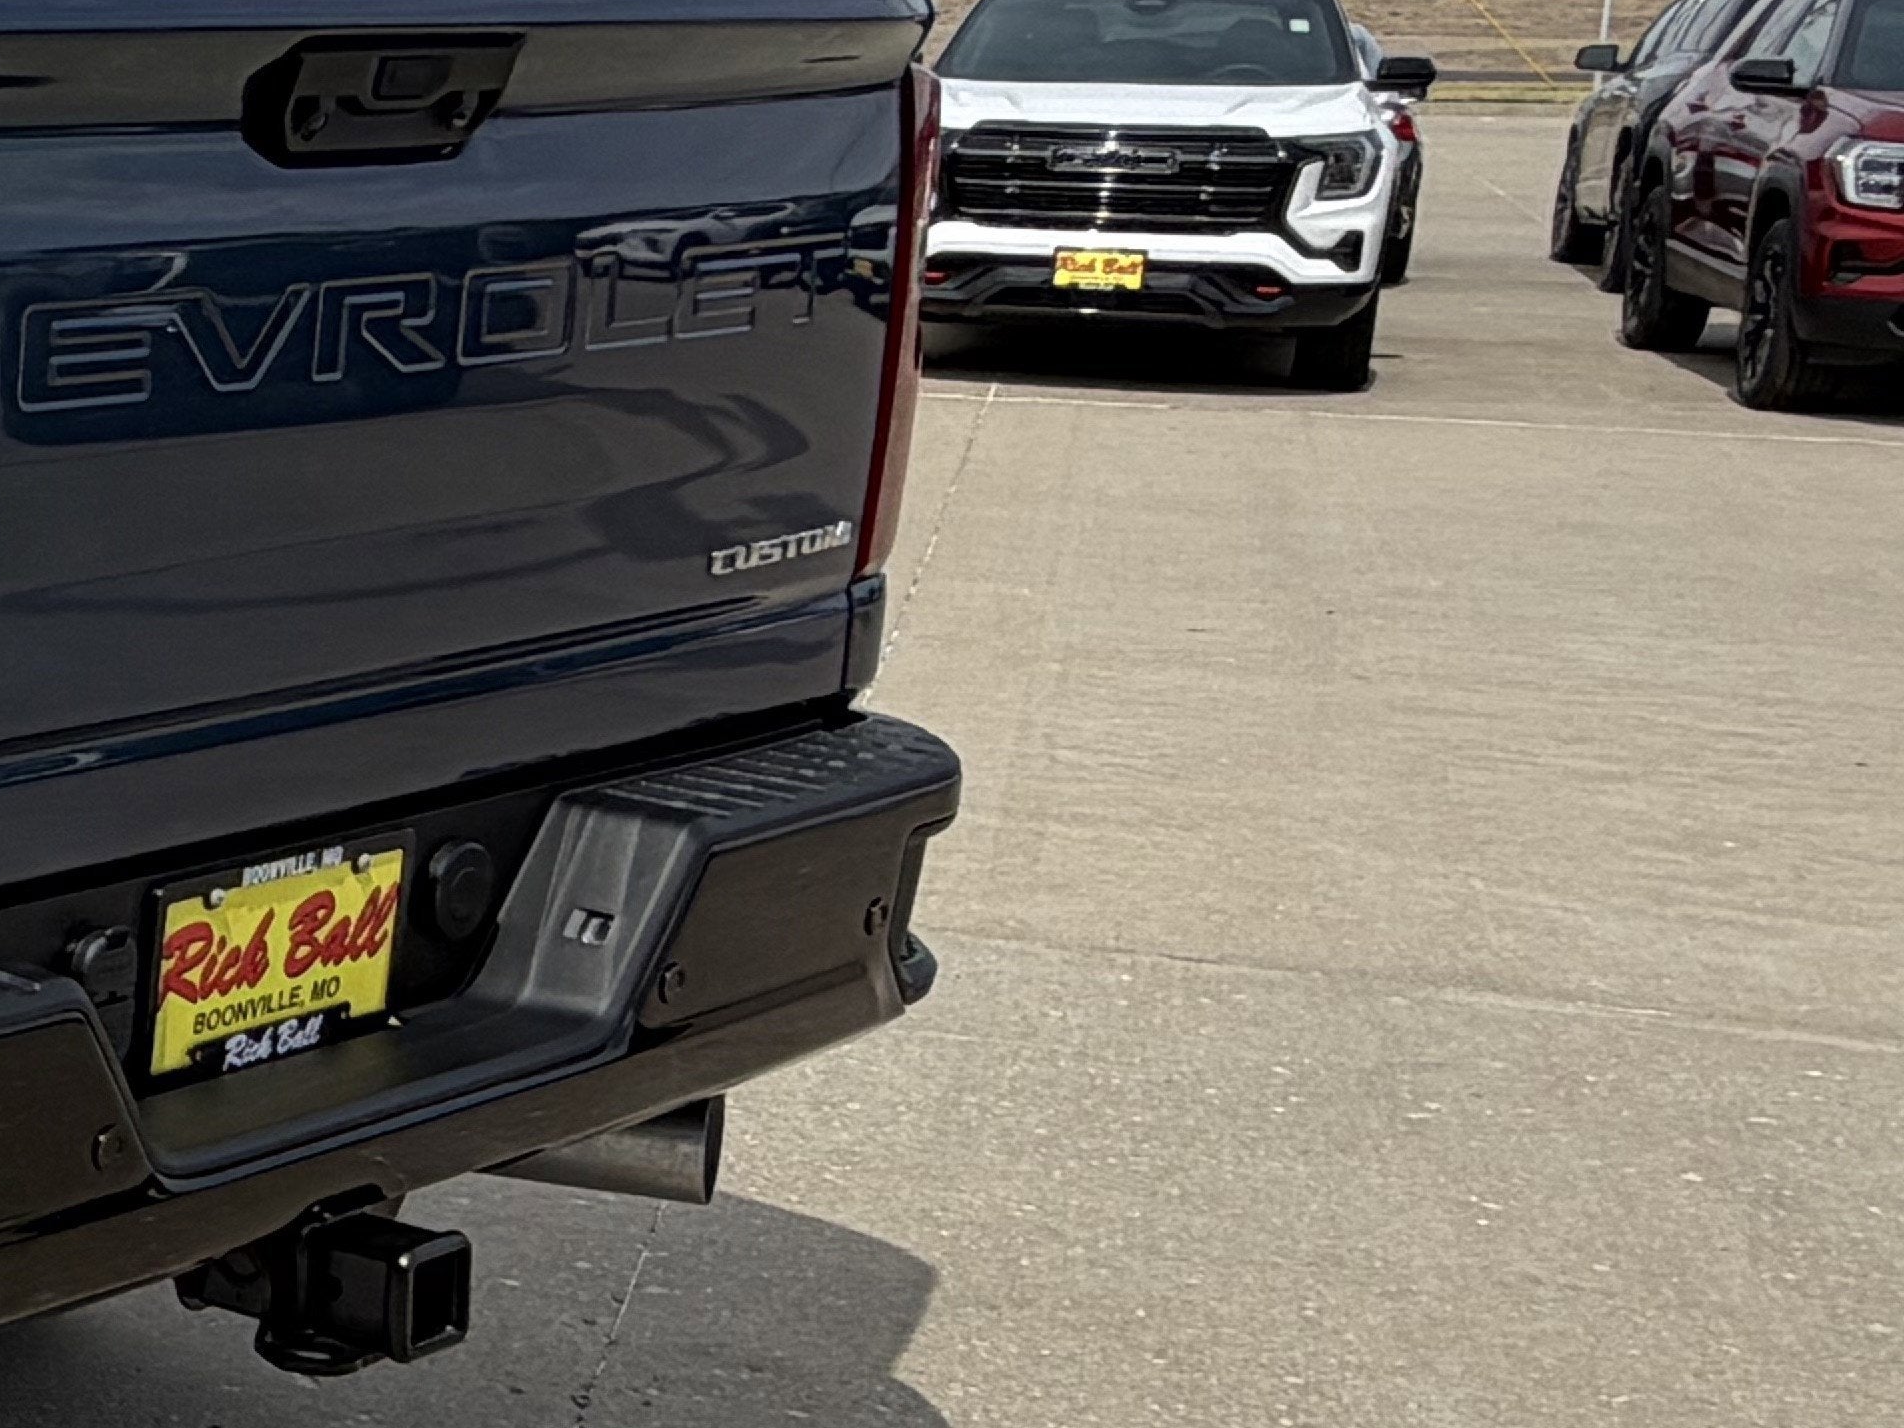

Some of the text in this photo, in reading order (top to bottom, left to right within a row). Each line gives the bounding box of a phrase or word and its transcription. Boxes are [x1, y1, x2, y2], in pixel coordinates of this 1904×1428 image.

[710, 521, 852, 576] CUSTOM
[156, 880, 402, 1013] Rick Ball
[192, 974, 341, 1035] BOONVILLE, MO
[223, 1013, 325, 1071] Rick Ball
